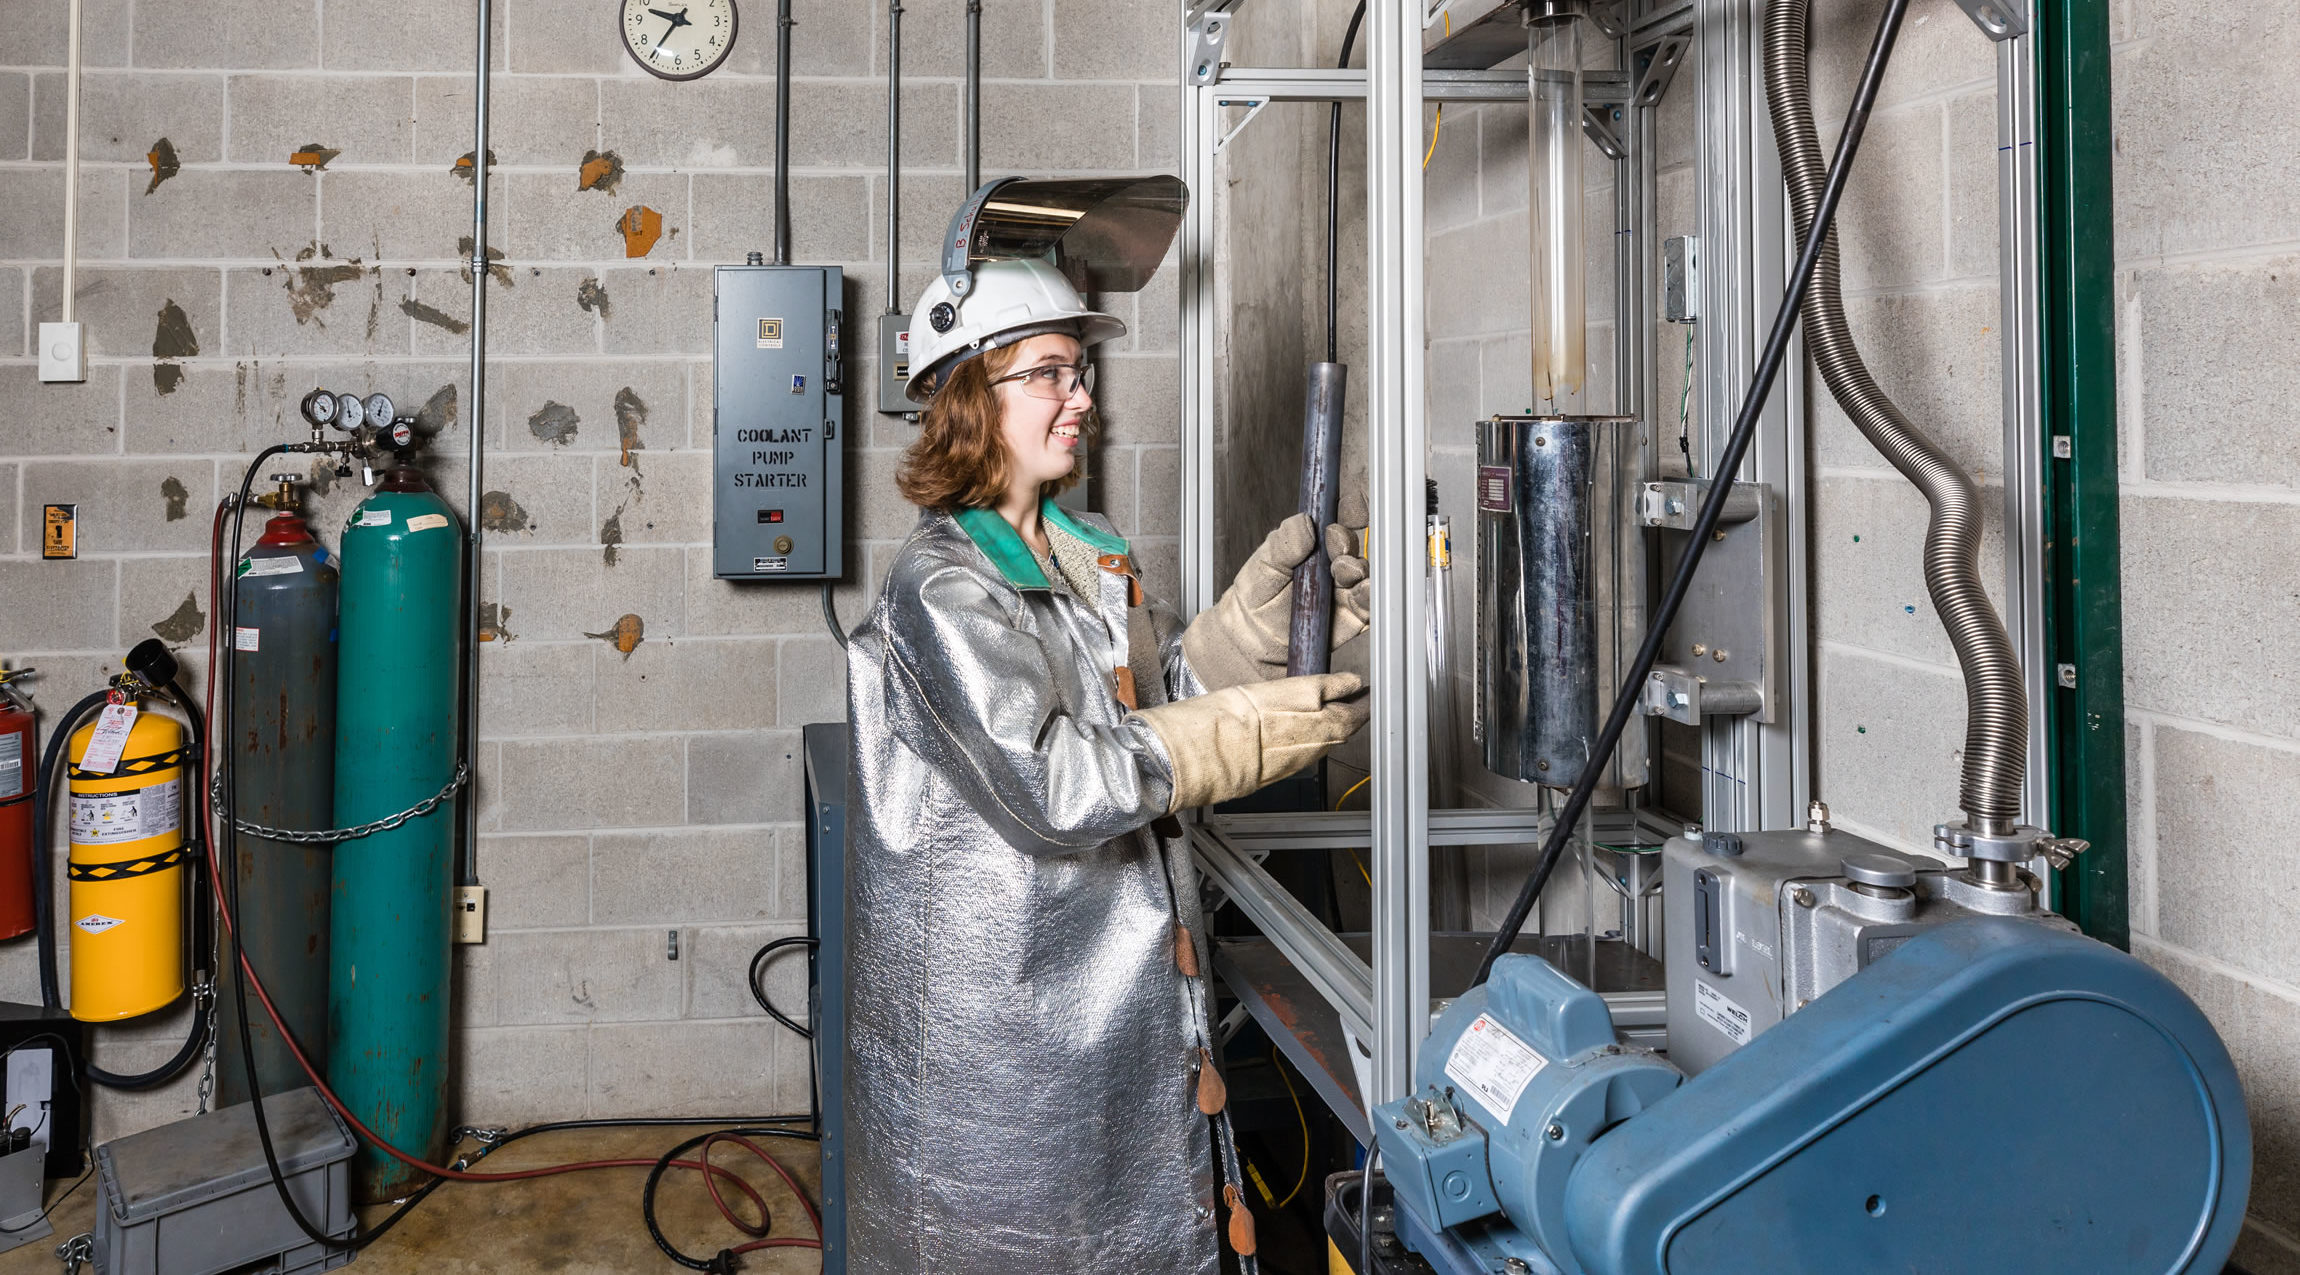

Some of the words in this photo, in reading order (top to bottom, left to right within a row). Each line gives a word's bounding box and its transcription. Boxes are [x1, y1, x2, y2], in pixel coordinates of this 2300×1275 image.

[635, 14, 643, 25] 9
[714, 15, 720, 27] 3
[640, 34, 648, 45] 8
[709, 35, 716, 46] 4
[674, 55, 682, 65] 6
[694, 49, 701, 60] 5
[737, 428, 812, 443] COOLANT
[752, 451, 794, 465] PUMP
[734, 473, 807, 488] STARTER
[1727, 1006, 1748, 1023] WELCH
